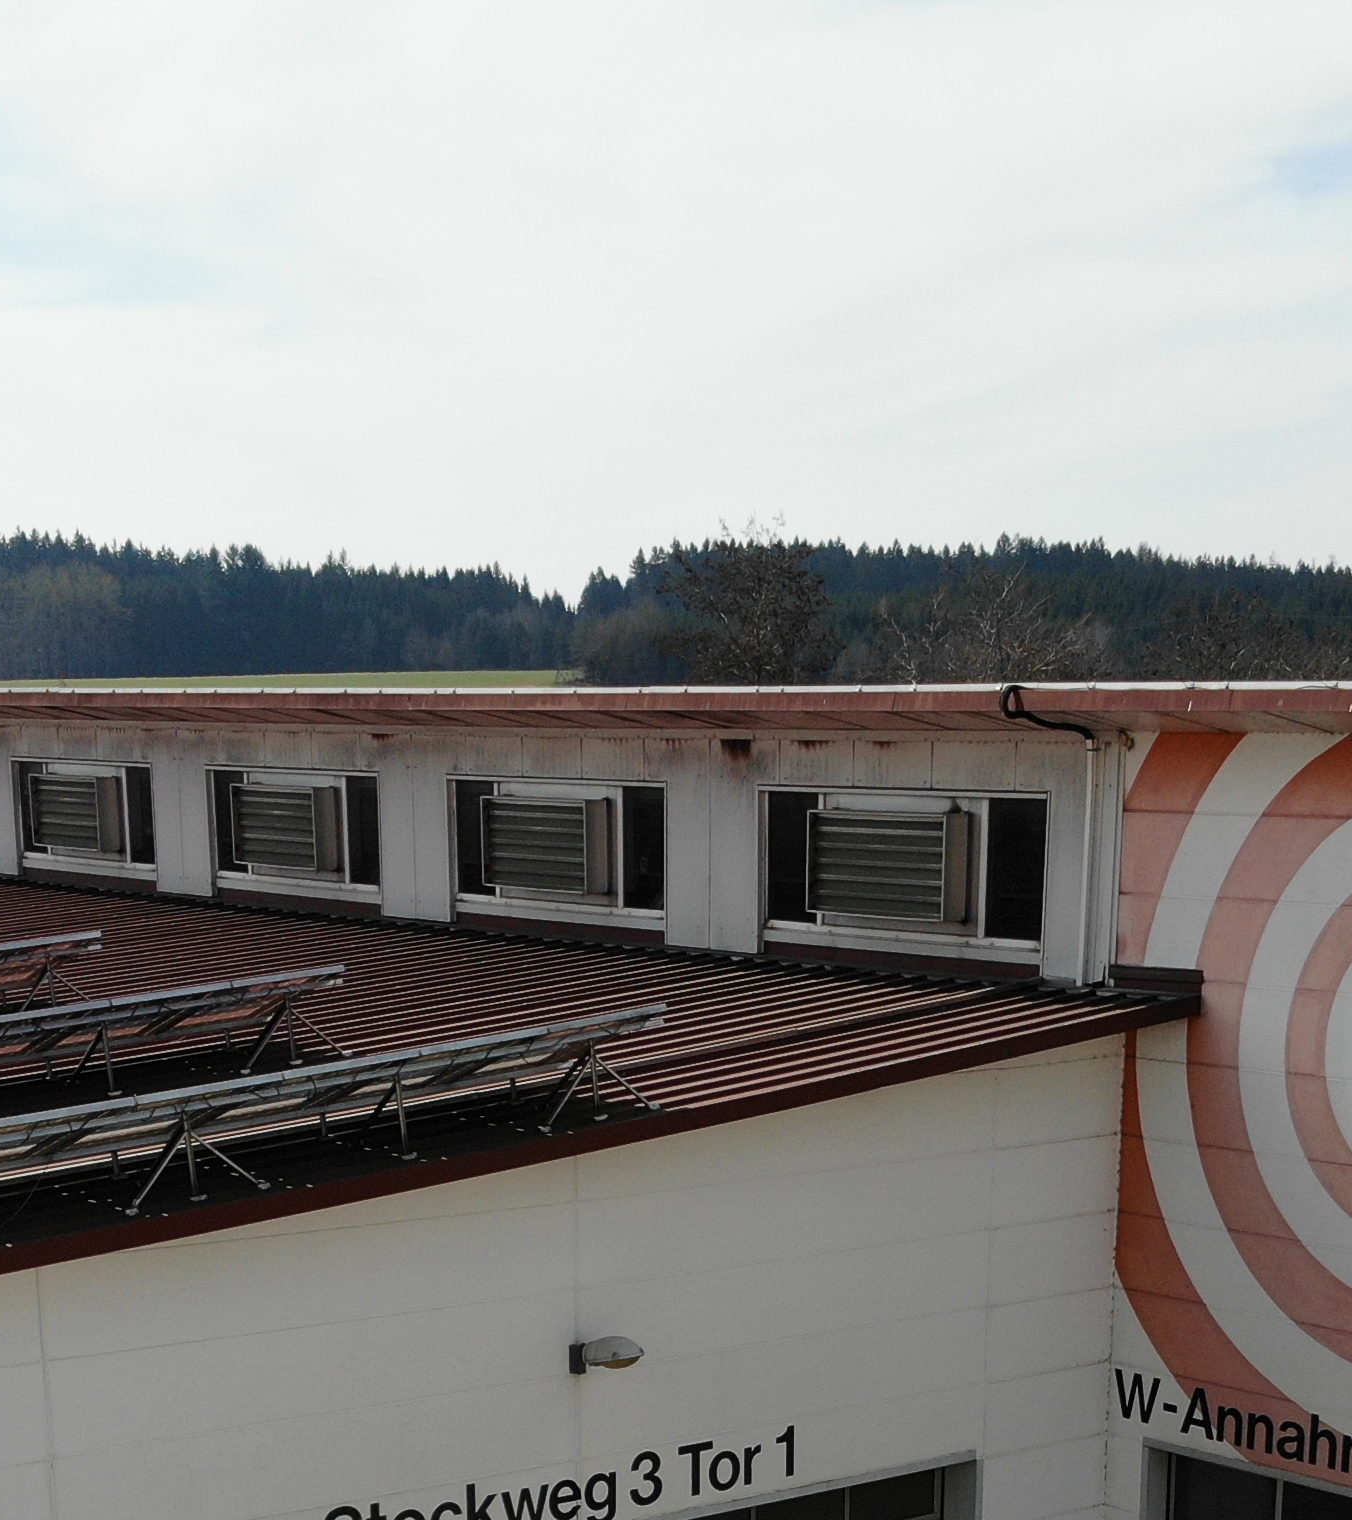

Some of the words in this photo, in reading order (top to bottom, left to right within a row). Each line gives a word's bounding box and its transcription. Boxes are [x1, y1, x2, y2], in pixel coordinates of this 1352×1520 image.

[629, 1450, 663, 1506] 3
[677, 1440, 762, 1497] Tor
[775, 1424, 796, 1477] 1
